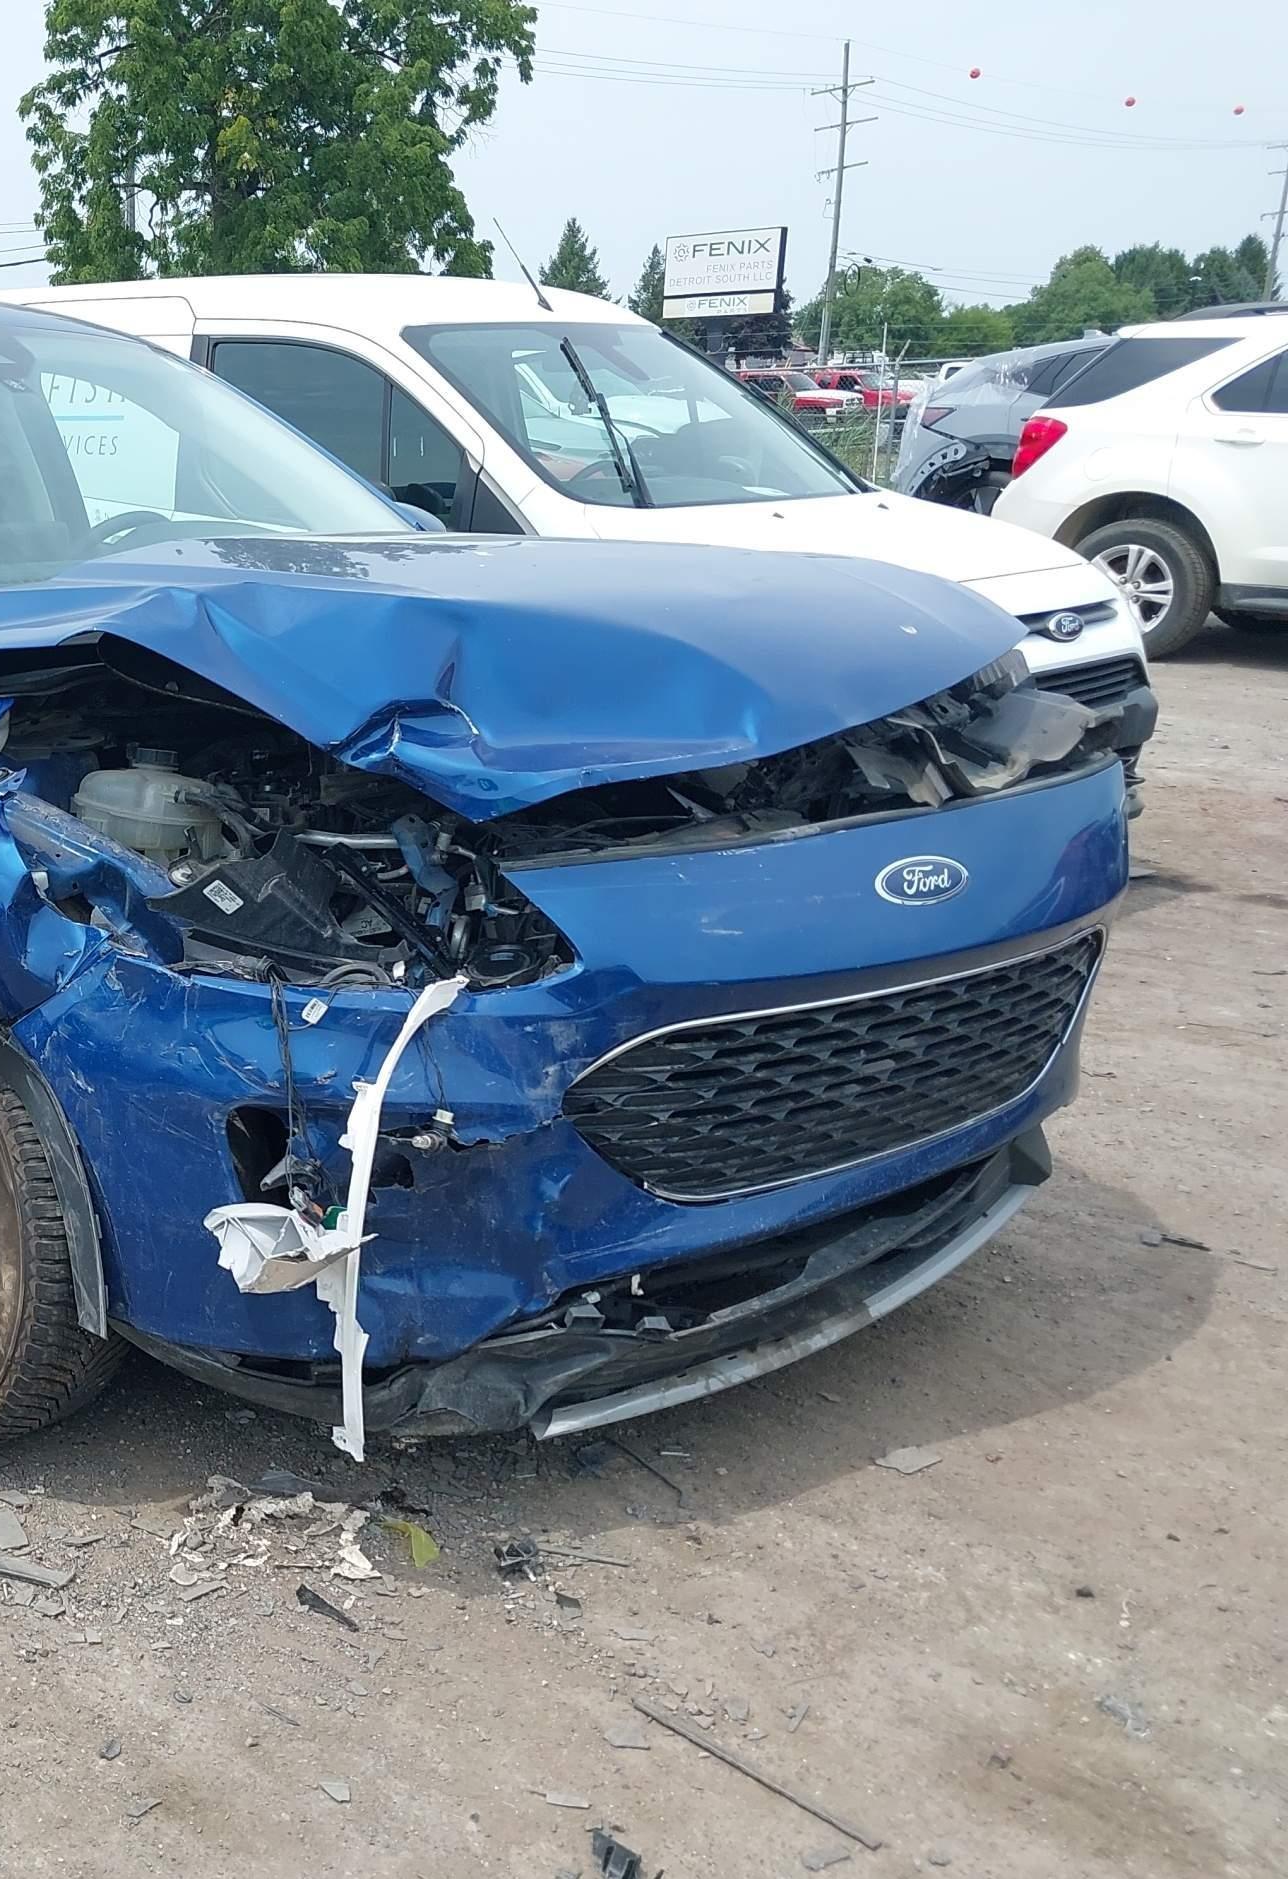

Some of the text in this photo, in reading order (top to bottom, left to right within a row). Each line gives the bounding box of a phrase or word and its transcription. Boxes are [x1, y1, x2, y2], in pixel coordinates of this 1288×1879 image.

[692, 238, 772, 259] FENIX
[706, 260, 774, 273] FENIX PARTS
[669, 271, 773, 288] DETROIT SOUTH LLC
[697, 296, 748, 309] FENIX
[1061, 616, 1080, 633] Ford
[902, 865, 952, 895] Ford
